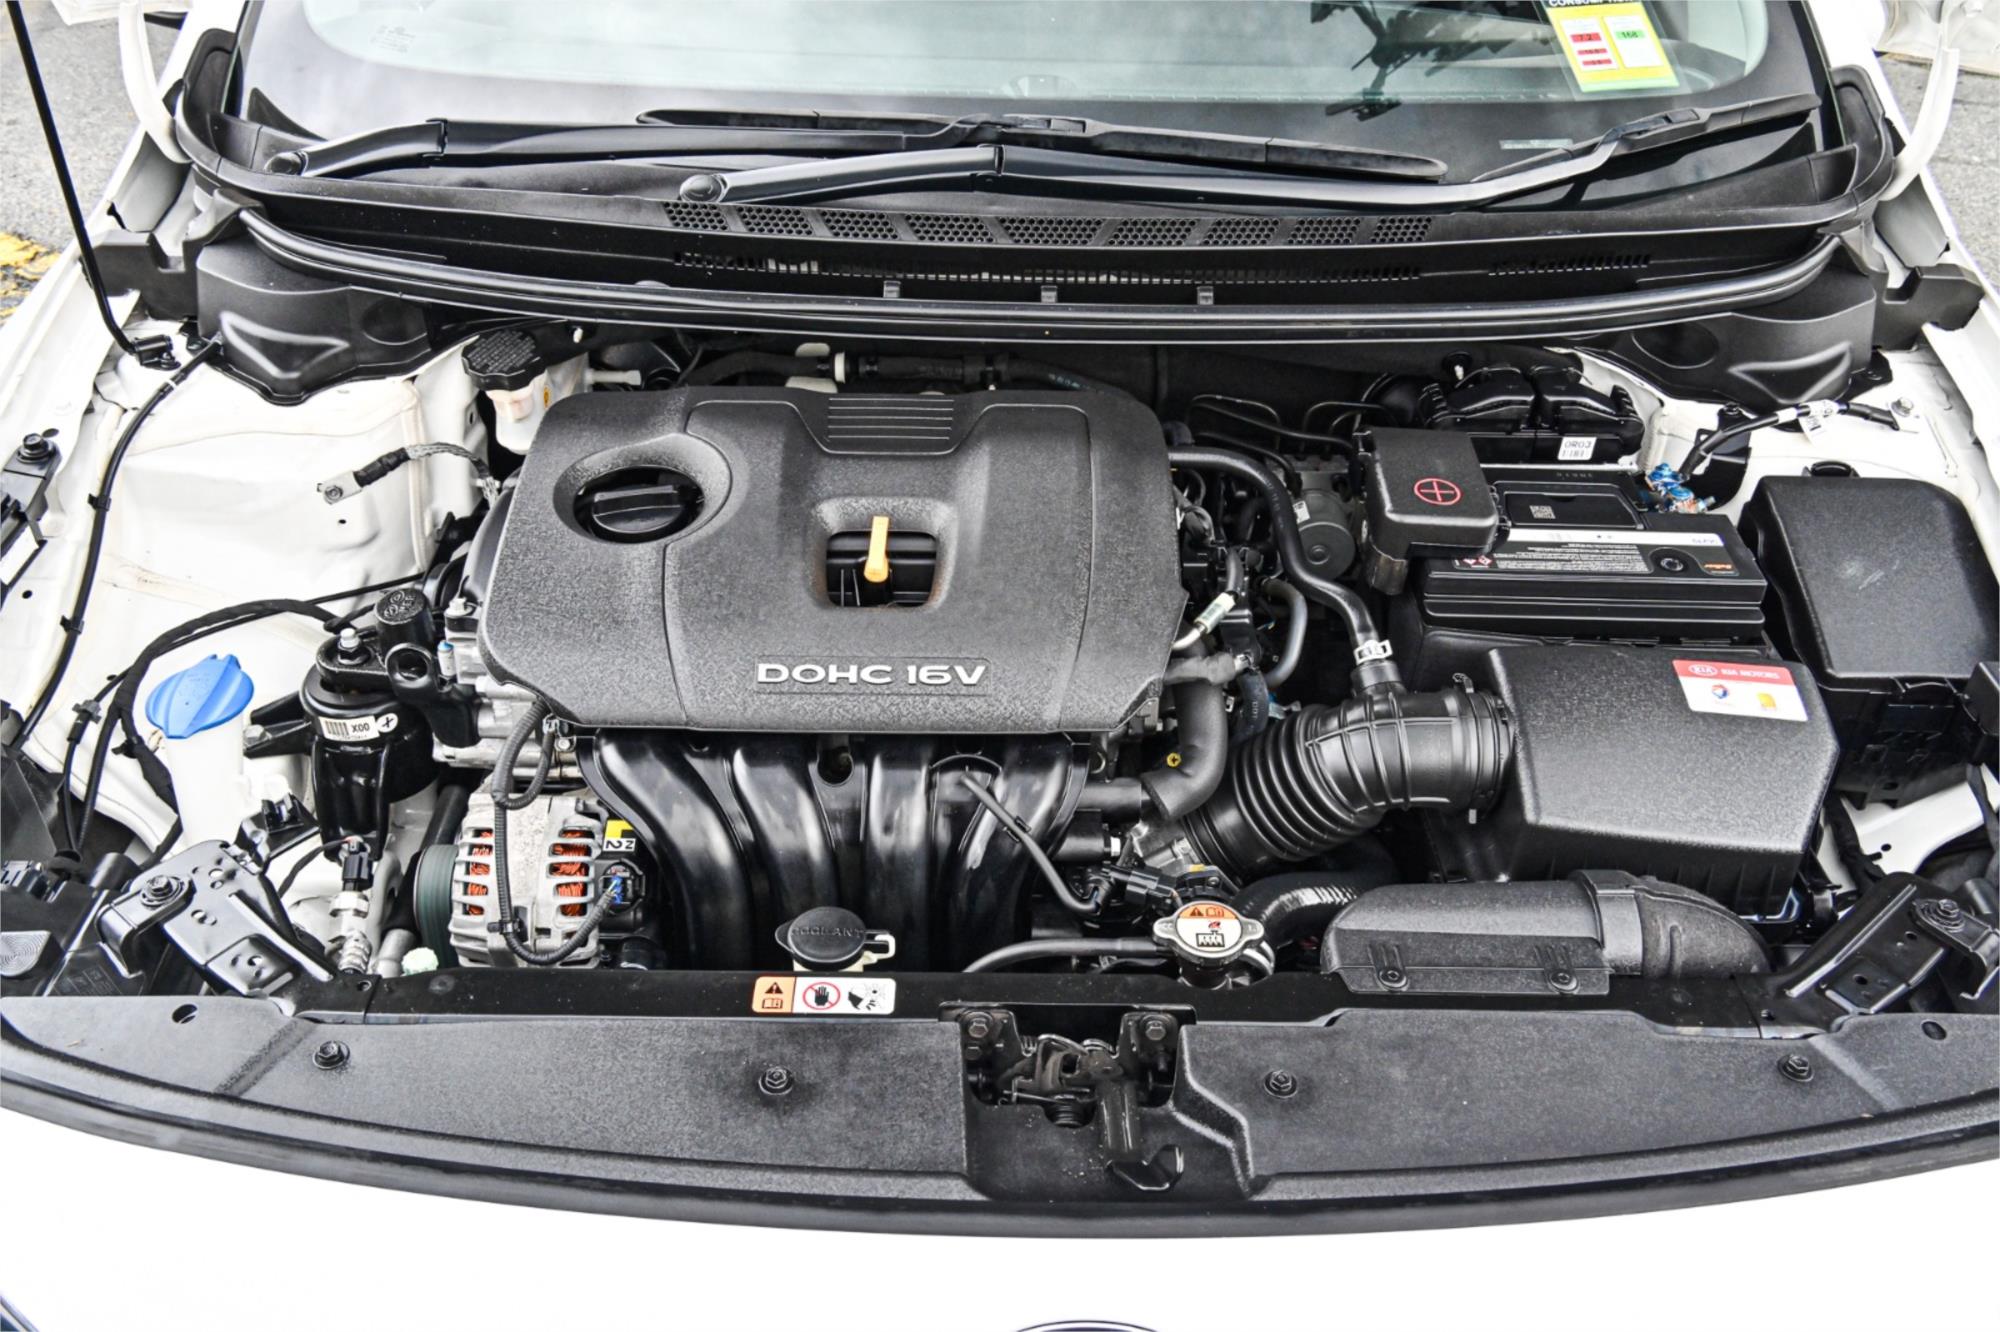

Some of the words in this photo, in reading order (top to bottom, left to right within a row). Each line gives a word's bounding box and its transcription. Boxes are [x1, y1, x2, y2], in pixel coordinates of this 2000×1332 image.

[757, 663, 893, 684] DOHC
[907, 664, 986, 686] 16V
[1721, 668, 1738, 676] KIA
[1740, 670, 1780, 679] MOTORS
[791, 926, 863, 938] COOLANT
